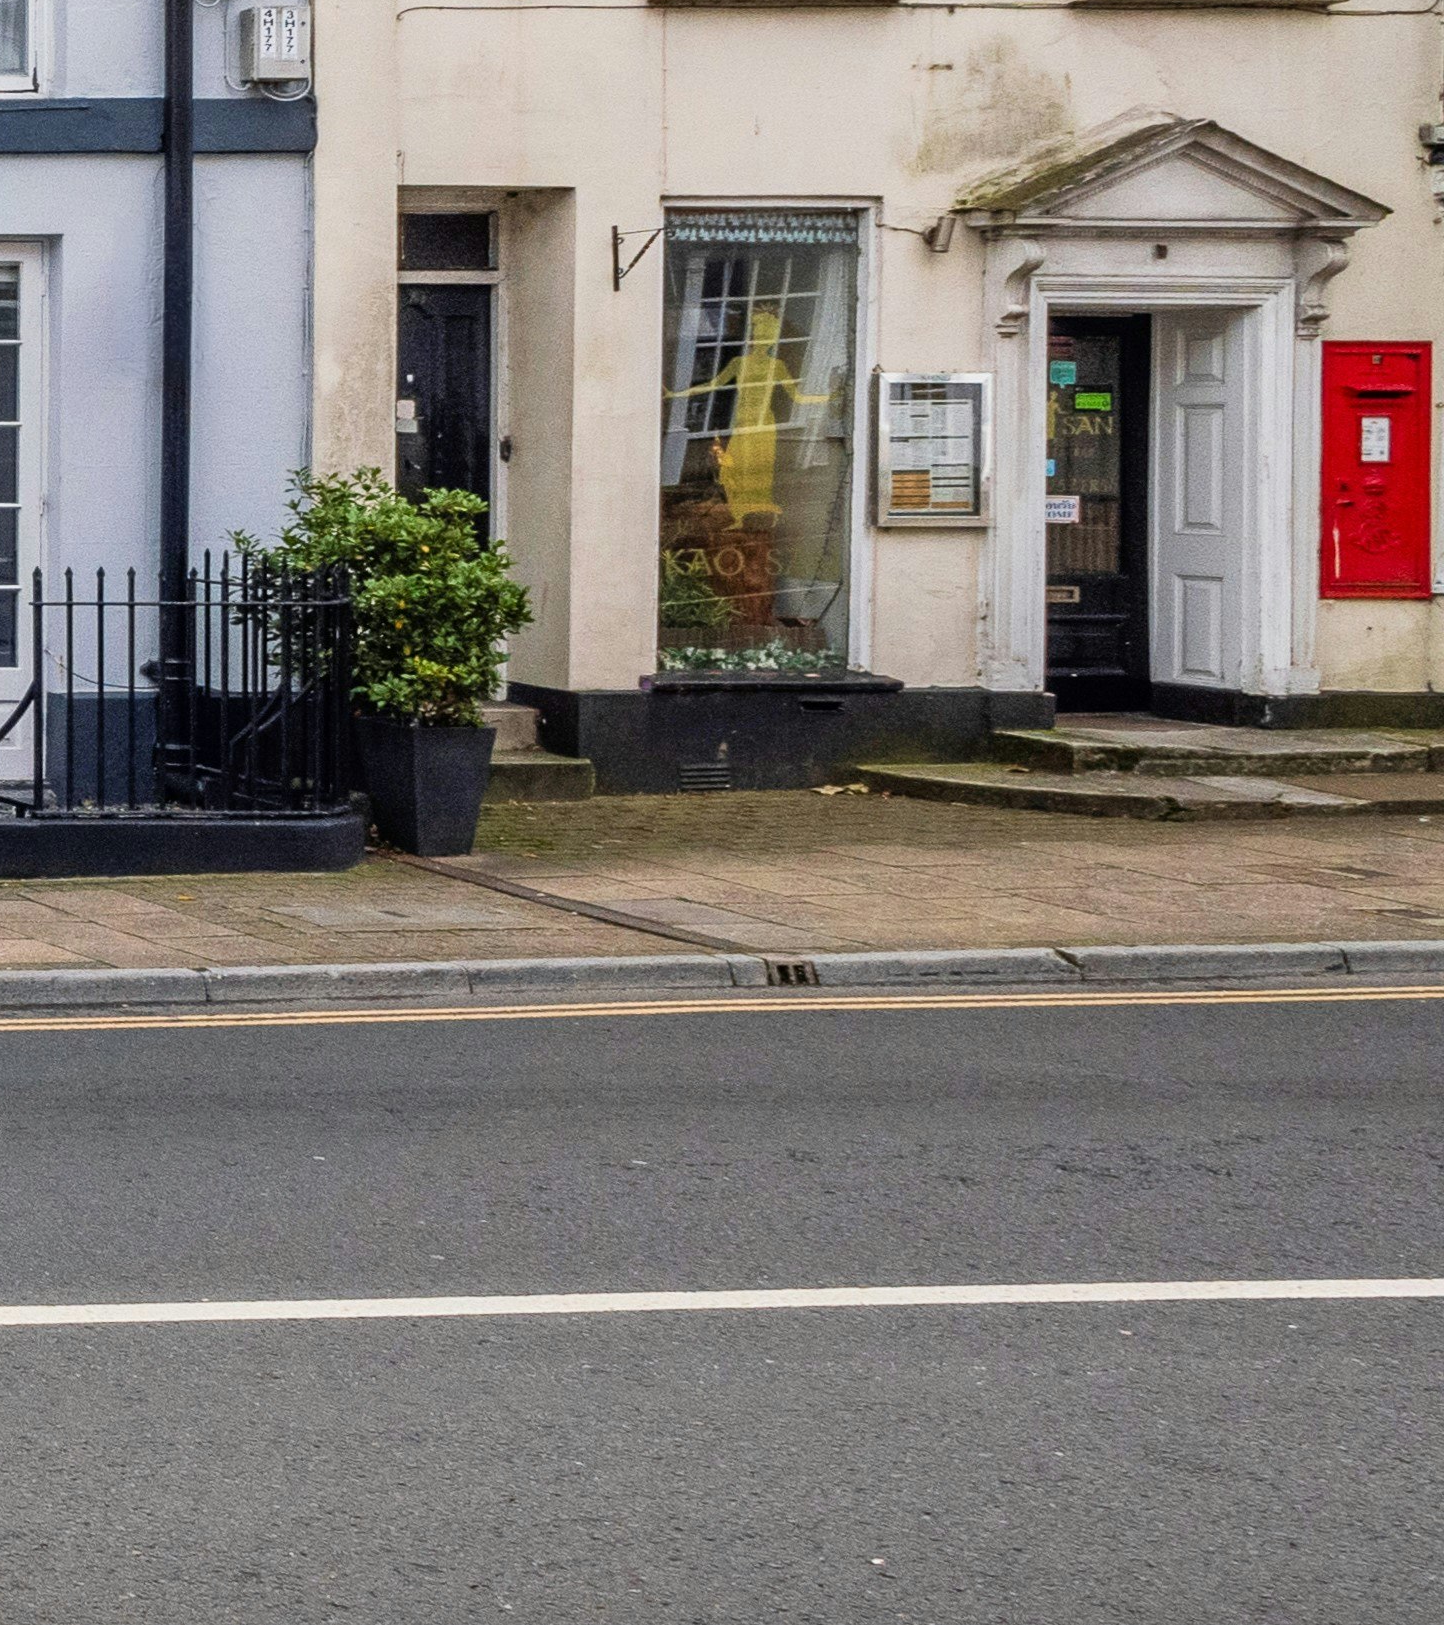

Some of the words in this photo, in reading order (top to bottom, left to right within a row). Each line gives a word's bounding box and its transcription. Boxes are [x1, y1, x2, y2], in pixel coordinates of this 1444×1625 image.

[263, 9, 274, 51] 4H177
[284, 10, 295, 53] 3H177
[1062, 415, 1114, 436] SAN
[664, 547, 744, 576] KAO
